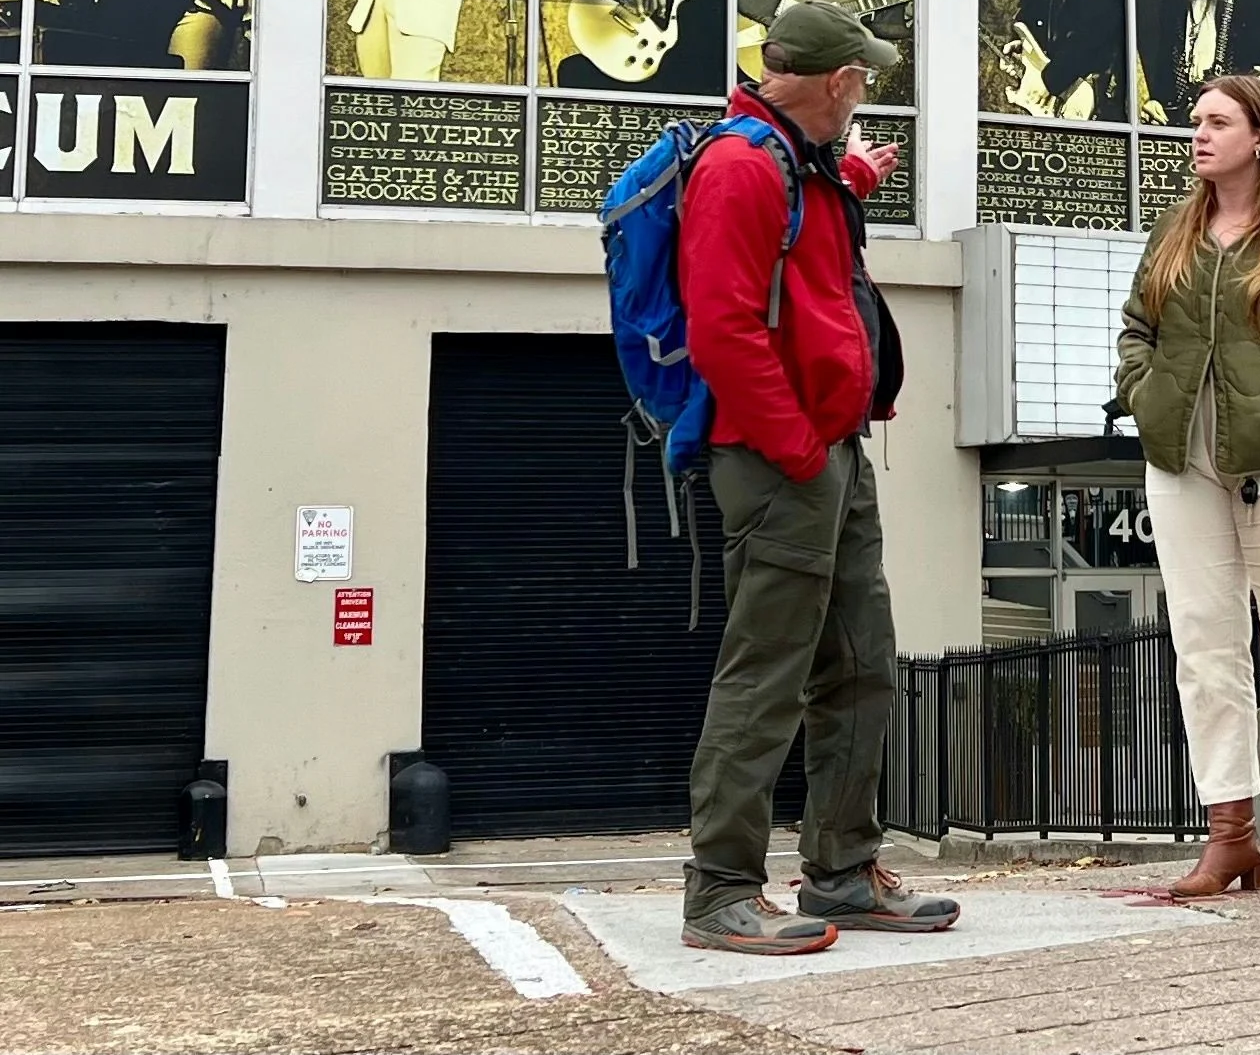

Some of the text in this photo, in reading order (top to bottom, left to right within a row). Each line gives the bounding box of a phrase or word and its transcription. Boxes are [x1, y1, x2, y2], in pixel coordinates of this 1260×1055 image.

[330, 93, 521, 112] THE MUSCLE
[542, 102, 722, 119] ALLEN REYNOLDS
[330, 105, 521, 122] SHOALS HORN SECTION
[329, 120, 521, 147] DON EVERLY
[542, 128, 611, 140] OWEN
[1034, 131, 1125, 147] RAY VAUGHN
[330, 146, 519, 165] STEVE WARINER
[541, 139, 621, 157] RICKY
[990, 138, 1126, 156] DOUBLE TROUBLE
[1139, 140, 1192, 157] BEN
[542, 157, 605, 168] FELIX
[978, 149, 1067, 174] TOTO
[1067, 156, 1126, 168] CHARLIE
[1140, 158, 1183, 172] ROY
[327, 164, 520, 187] GARTH & THE
[541, 169, 600, 185] DON
[978, 171, 1073, 187] CORKI CASEY
[1068, 166, 1125, 178] DANIELS
[1139, 174, 1176, 190] AL
[327, 182, 519, 204] BROOKS G-MEN
[978, 184, 1127, 203] BARBARA MANDRELL
[539, 199, 592, 209] STUDIO
[978, 197, 1126, 215] RANDY BACHMAN
[1071, 215, 1127, 232] COX
[318, 520, 332, 528] NO
[302, 529, 348, 537] PARKING
